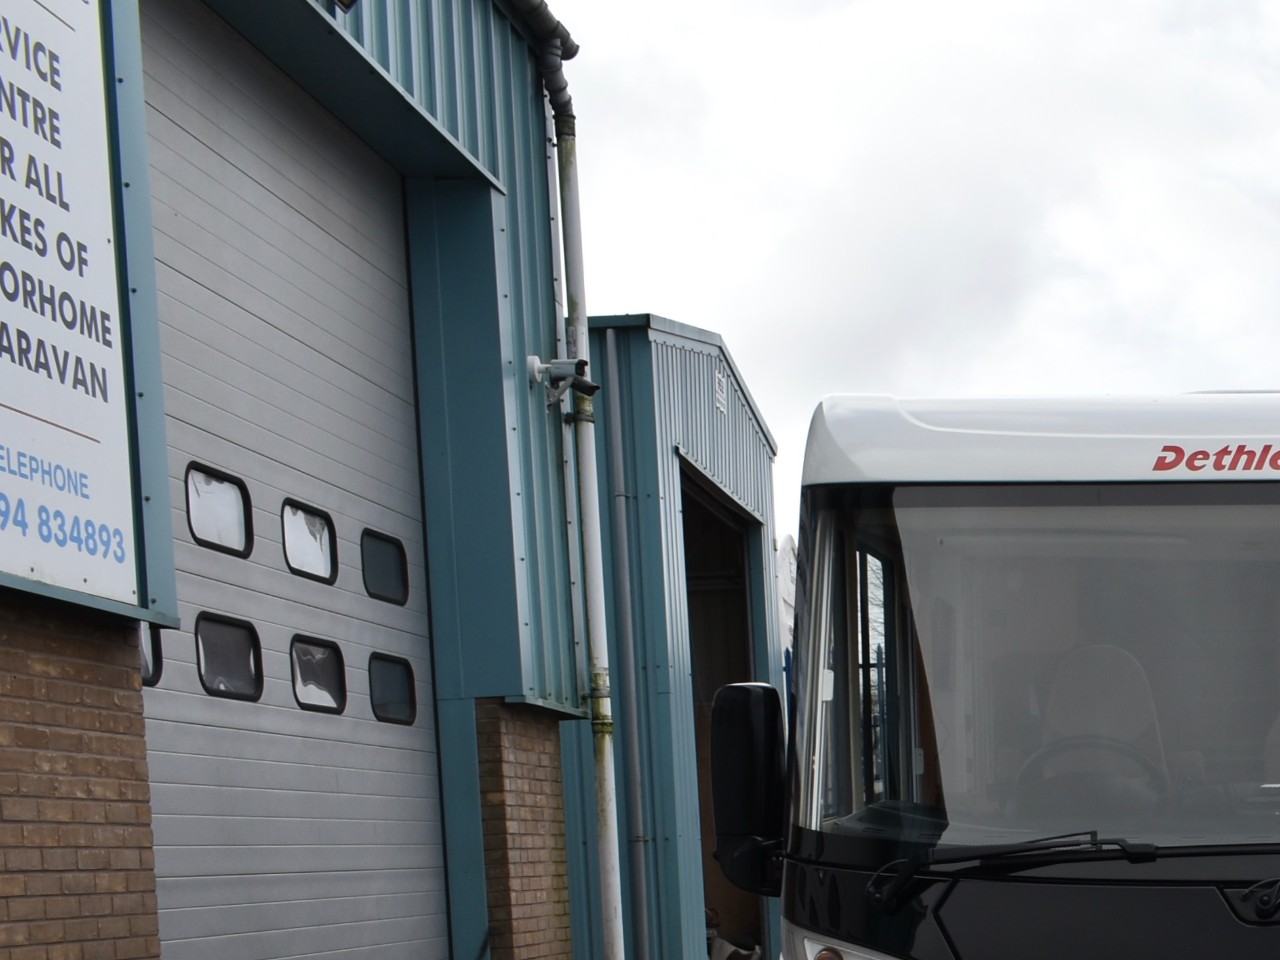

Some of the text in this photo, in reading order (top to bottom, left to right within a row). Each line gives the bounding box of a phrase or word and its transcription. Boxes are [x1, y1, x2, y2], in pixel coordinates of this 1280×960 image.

[0, 15, 61, 92] VICE
[25, 154, 70, 213] ALL
[0, 197, 88, 278] KES OF
[0, 261, 113, 349] ORHOME
[0, 320, 108, 404] ARAVAN
[0, 492, 125, 564] 94 834893
